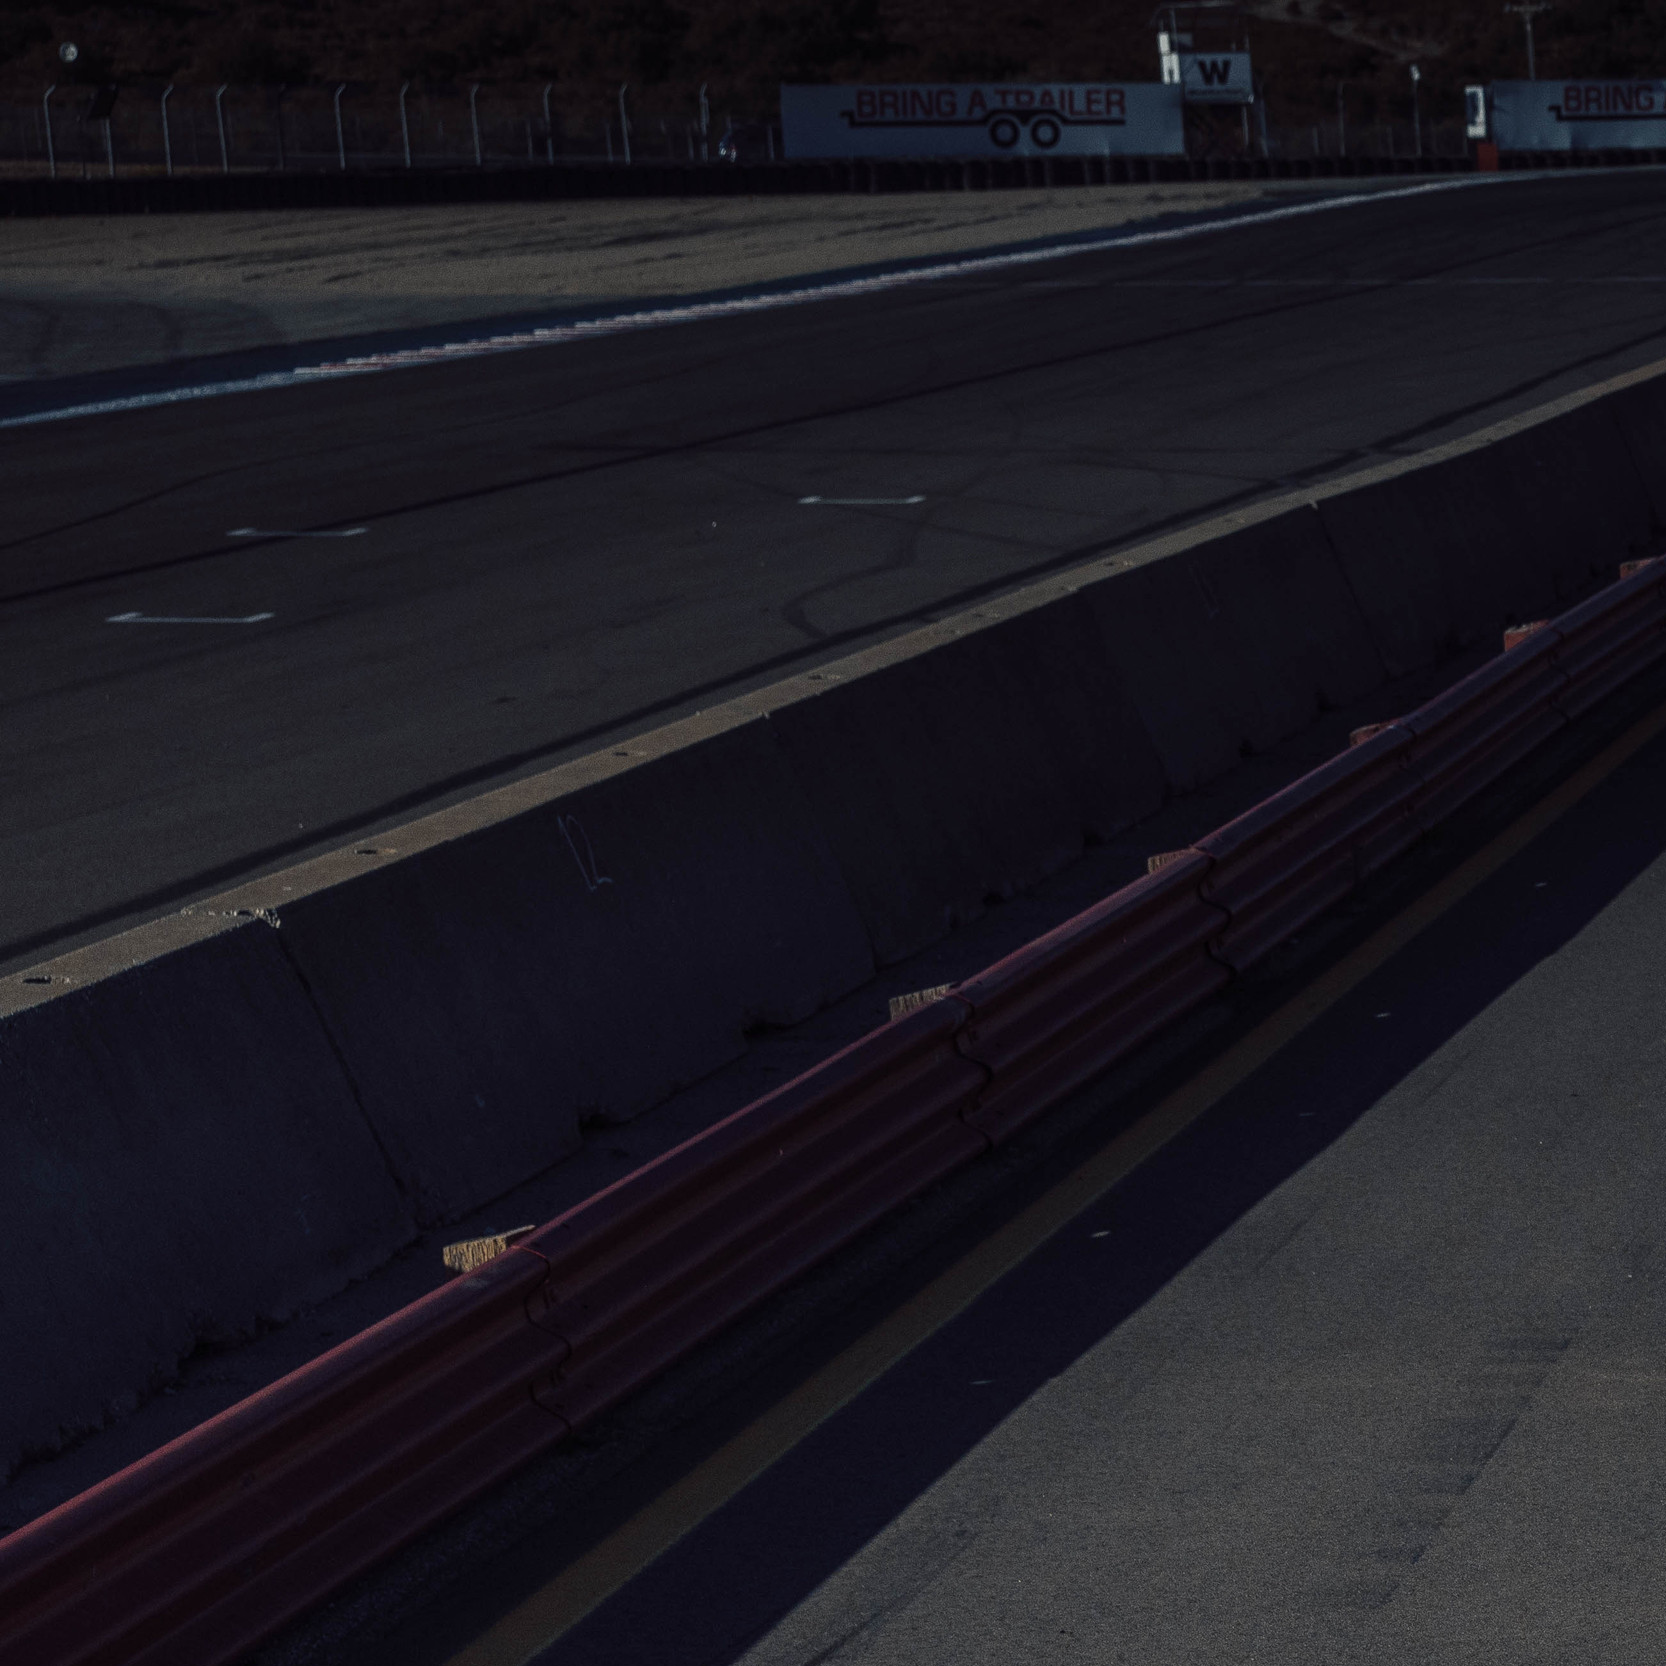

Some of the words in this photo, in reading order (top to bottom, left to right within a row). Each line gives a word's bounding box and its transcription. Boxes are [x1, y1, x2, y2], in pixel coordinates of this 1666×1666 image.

[1198, 60, 1231, 86] W
[856, 89, 957, 118] BRING
[967, 88, 988, 116] A
[1000, 87, 1126, 116] TRAILER
[1564, 86, 1654, 113] BRING
